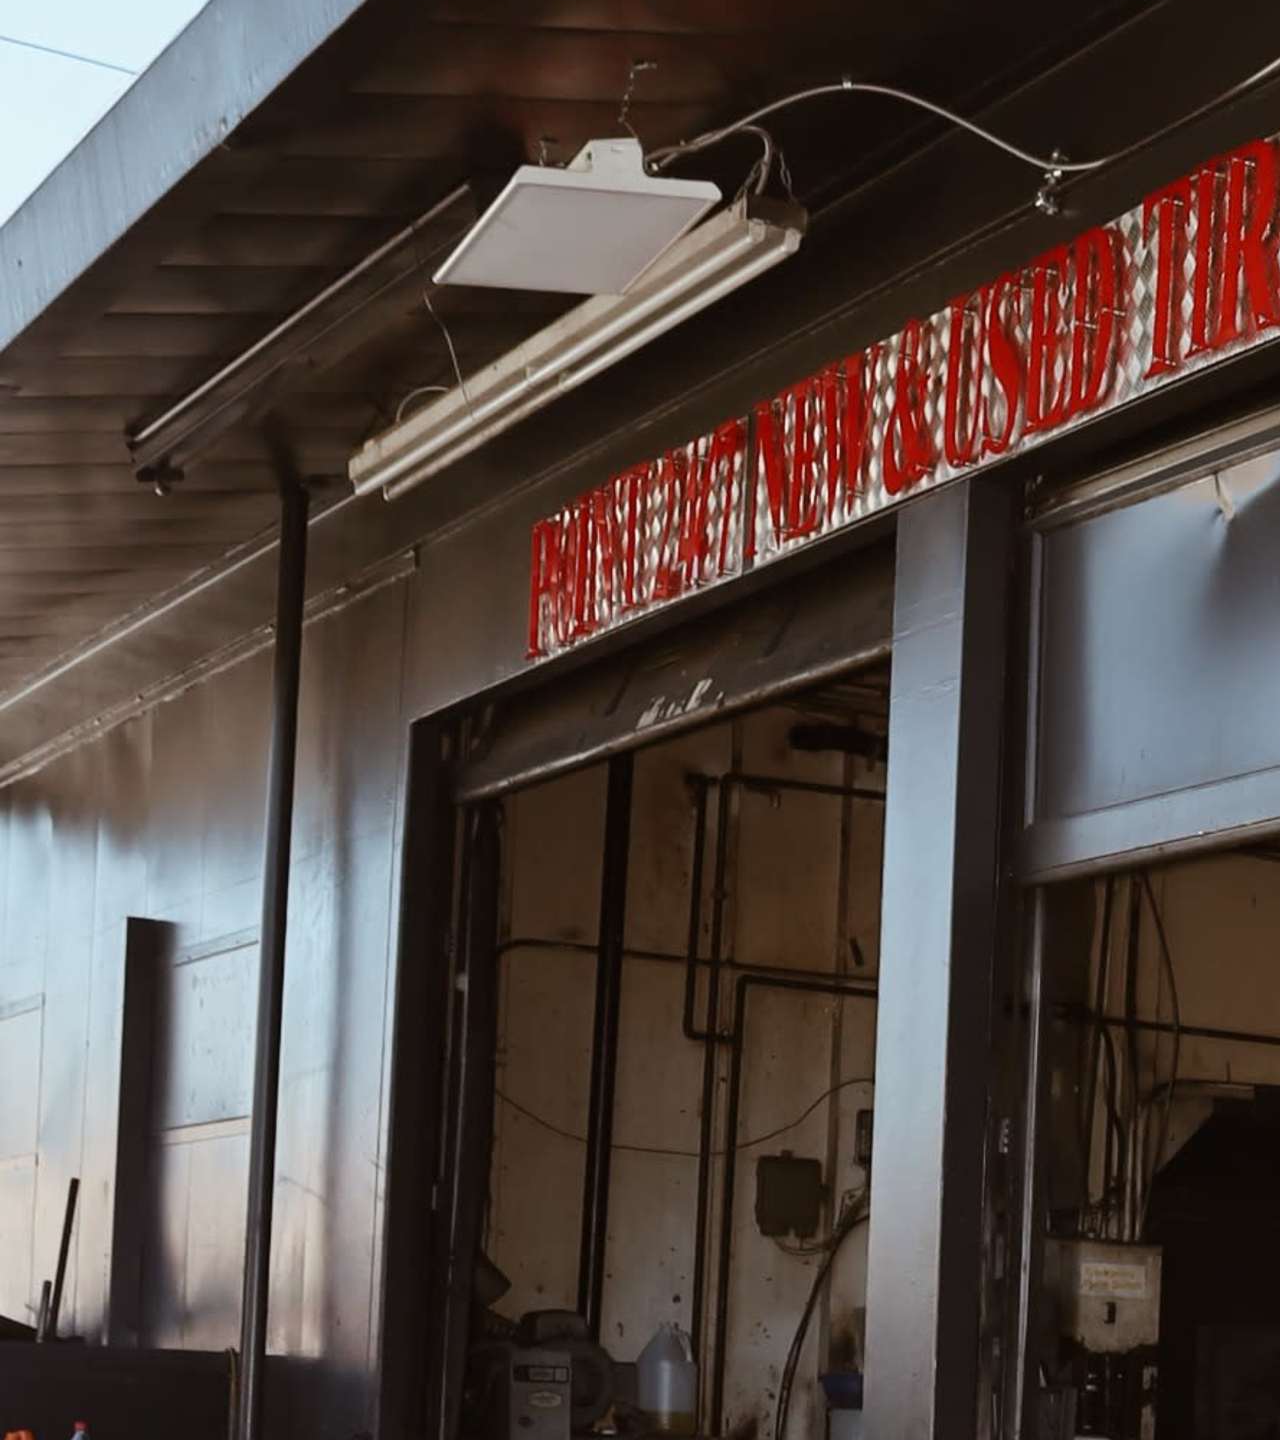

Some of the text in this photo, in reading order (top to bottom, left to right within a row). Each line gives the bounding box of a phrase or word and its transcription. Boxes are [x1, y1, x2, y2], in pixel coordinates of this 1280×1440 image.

[747, 337, 884, 561] NEW
[883, 317, 939, 497] &
[944, 225, 1120, 471] USED
